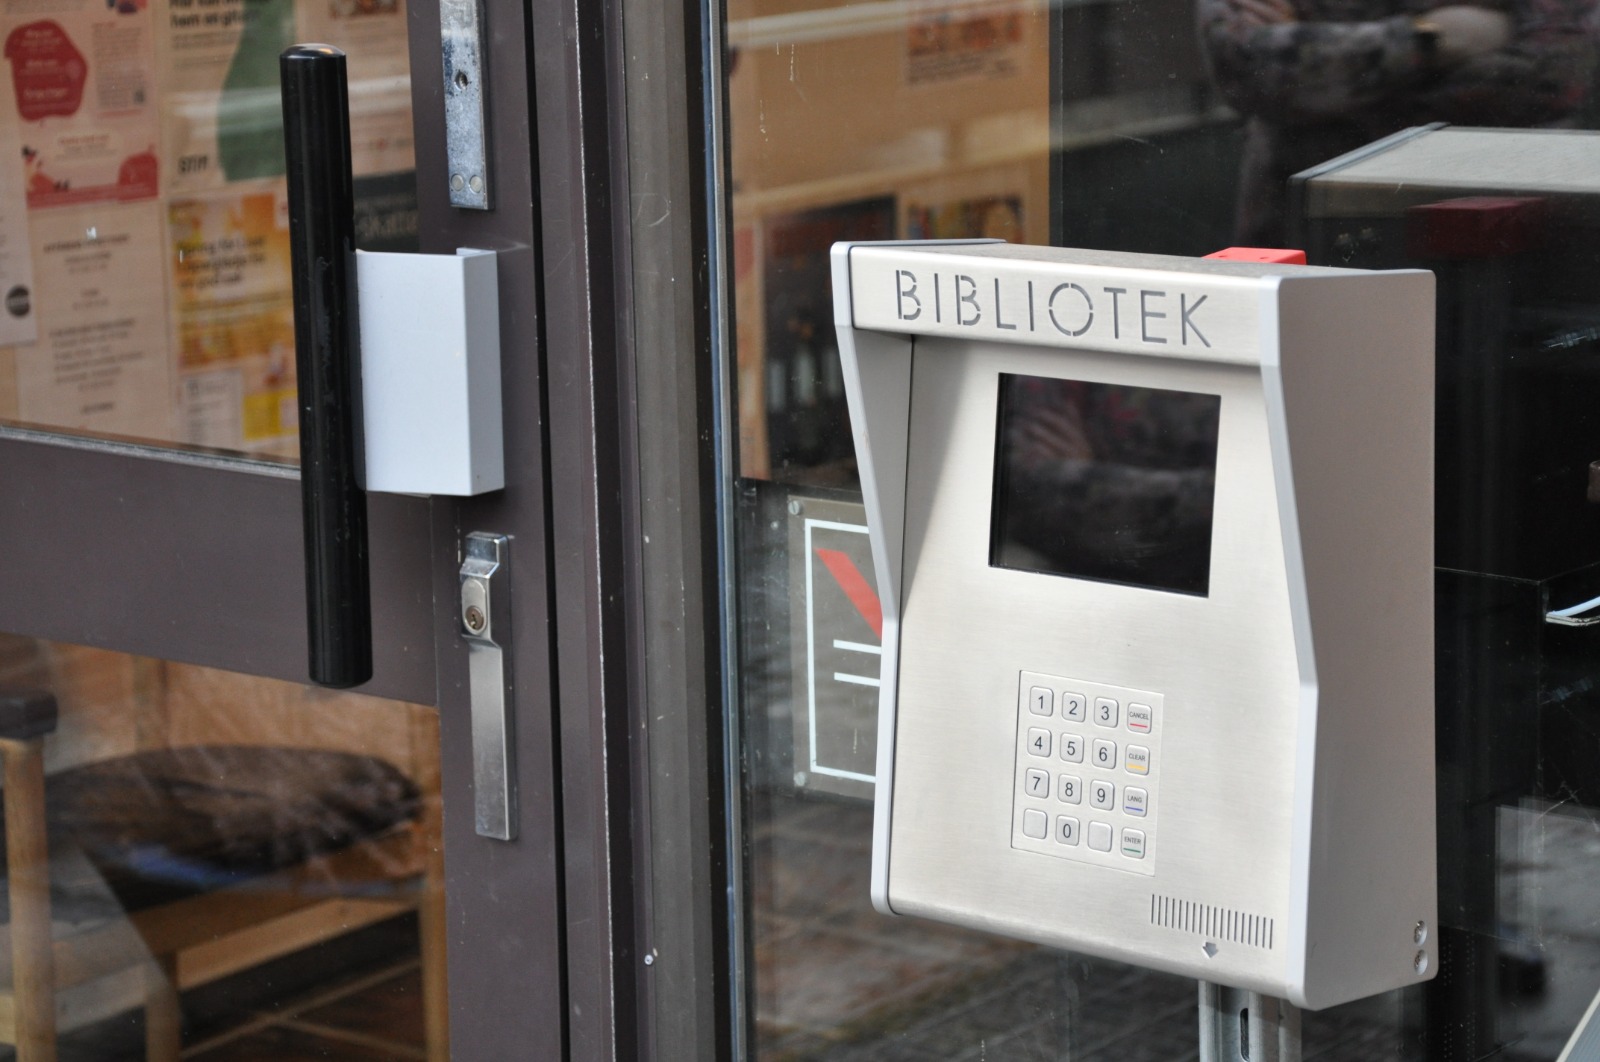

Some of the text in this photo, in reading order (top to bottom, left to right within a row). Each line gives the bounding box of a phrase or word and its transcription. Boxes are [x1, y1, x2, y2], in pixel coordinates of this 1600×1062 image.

[895, 269, 1212, 348] BIBLIOTEK
[1038, 695, 1044, 709] 1
[1069, 701, 1077, 715] 2
[1101, 706, 1110, 720] 3
[1129, 711, 1149, 720] CANCEL
[1034, 736, 1043, 750] 4
[1067, 741, 1076, 756] 5
[1099, 747, 1108, 761] 6
[1128, 753, 1146, 762] CLEAR
[1032, 777, 1041, 790] 7
[1065, 782, 1073, 797] 8
[1097, 788, 1106, 803] 9
[1127, 795, 1143, 804] LANG
[1063, 823, 1072, 838] 0
[1124, 836, 1142, 845] ENTER
